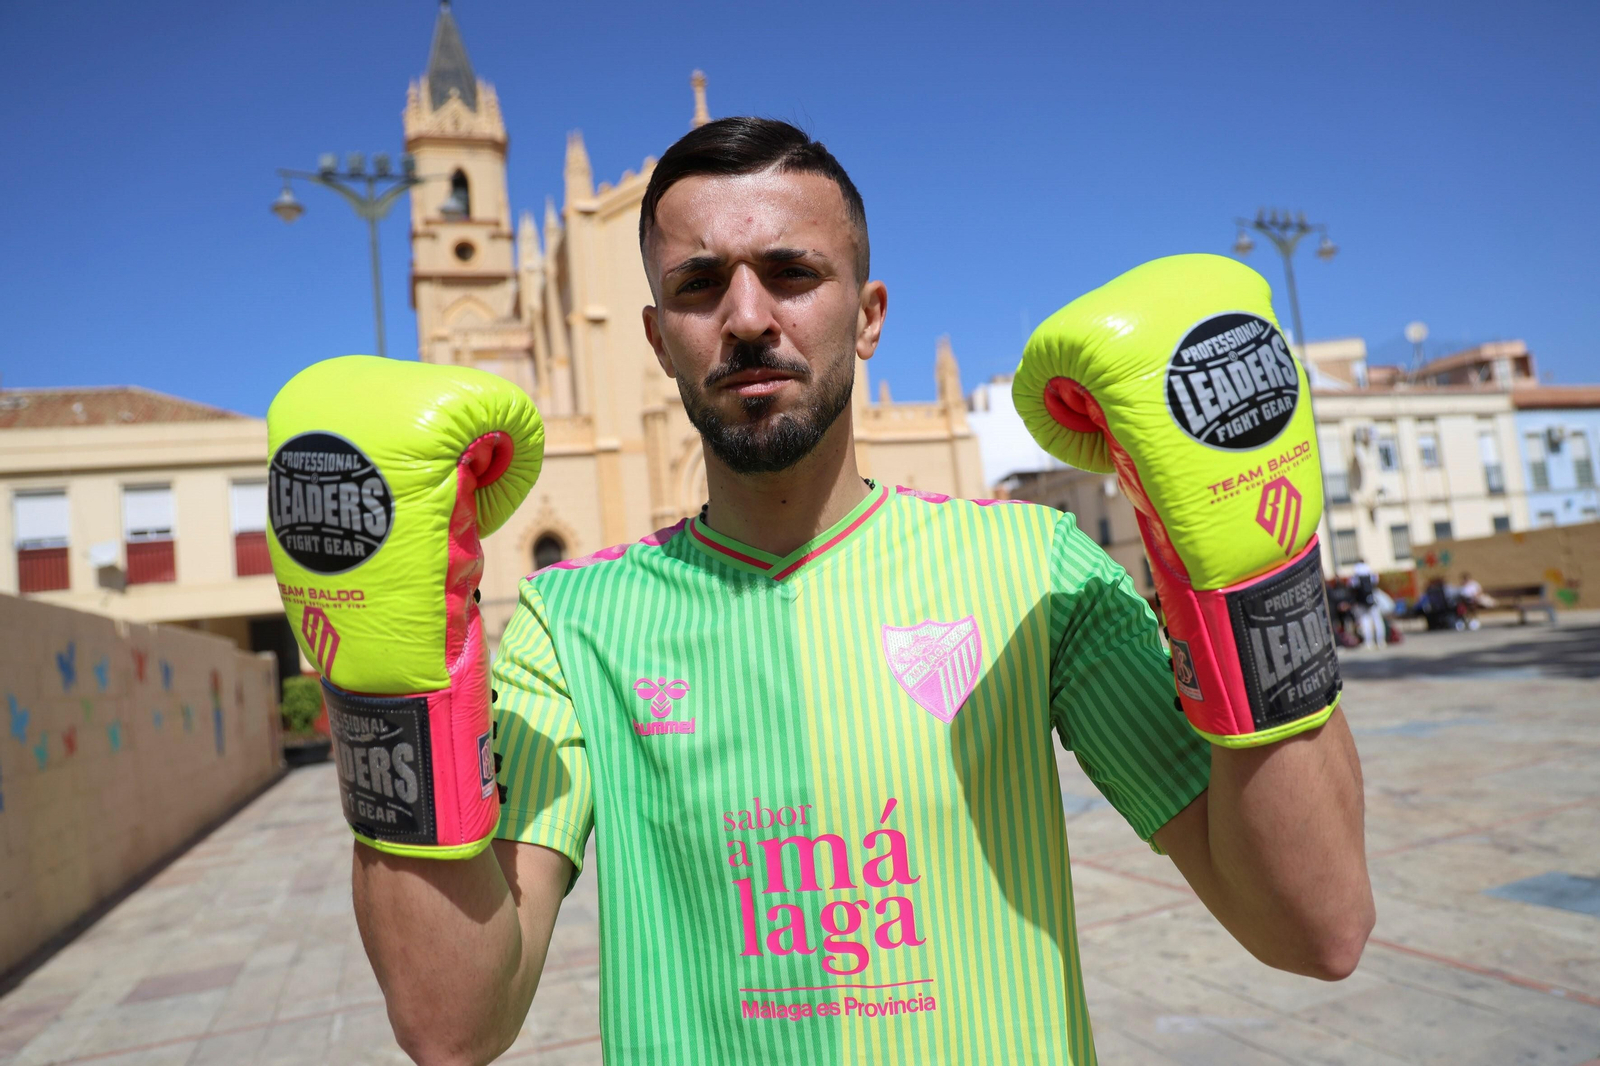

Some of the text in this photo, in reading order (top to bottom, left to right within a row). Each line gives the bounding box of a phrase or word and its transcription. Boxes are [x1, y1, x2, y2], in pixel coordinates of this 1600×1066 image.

[1180, 319, 1264, 364] PROFESSIONAL
[1170, 333, 1298, 435] LEADERS
[1215, 395, 1294, 443] FIGHT GEAR
[281, 450, 362, 472] PROFESSIONAL
[1207, 440, 1311, 495] TEAM BALDO
[270, 469, 387, 537] LEADERS
[286, 534, 366, 557] FIGHT GEAR
[277, 582, 305, 598] TEAM
[308, 587, 365, 602] BALDO
[1250, 602, 1332, 692] LEADE
[1287, 667, 1328, 703] FIGHT
[632, 717, 696, 736] hummel
[338, 742, 418, 804] DERS
[358, 800, 397, 824] GEAR
[723, 797, 812, 831] sabor
[727, 797, 921, 894] a má
[732, 877, 927, 976] laga
[741, 992, 936, 1021] Málaga es Provincia
